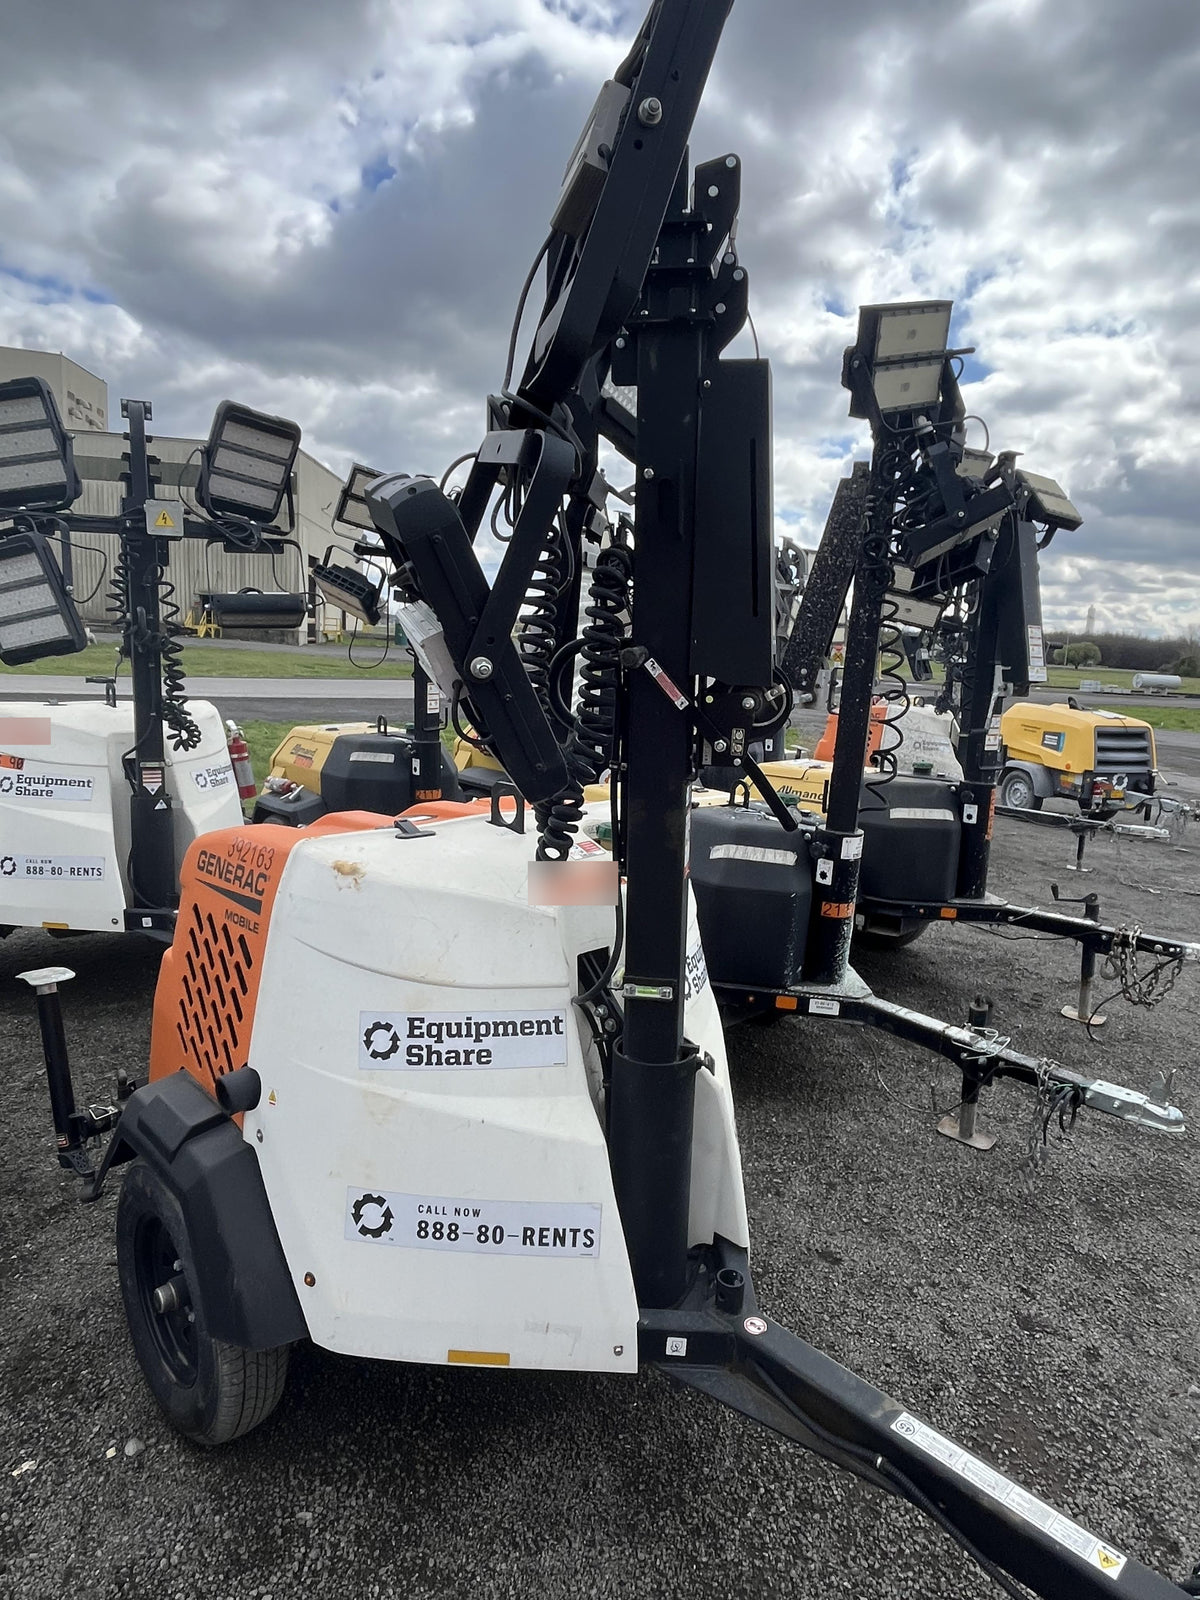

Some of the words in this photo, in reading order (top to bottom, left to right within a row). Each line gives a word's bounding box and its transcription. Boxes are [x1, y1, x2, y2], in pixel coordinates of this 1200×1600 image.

[15, 786, 54, 797] Share
[16, 774, 93, 788] Equipment
[227, 836, 275, 871] 392163
[26, 865, 103, 877] 888-80-RENTS
[197, 850, 268, 897] GENERAC
[224, 908, 260, 934] MOBILE
[406, 1015, 564, 1043] Equipment
[405, 1044, 492, 1066] Share
[417, 1204, 448, 1216] CALL
[454, 1207, 481, 1218] NOW
[416, 1220, 596, 1248] 888-80-RENTS
